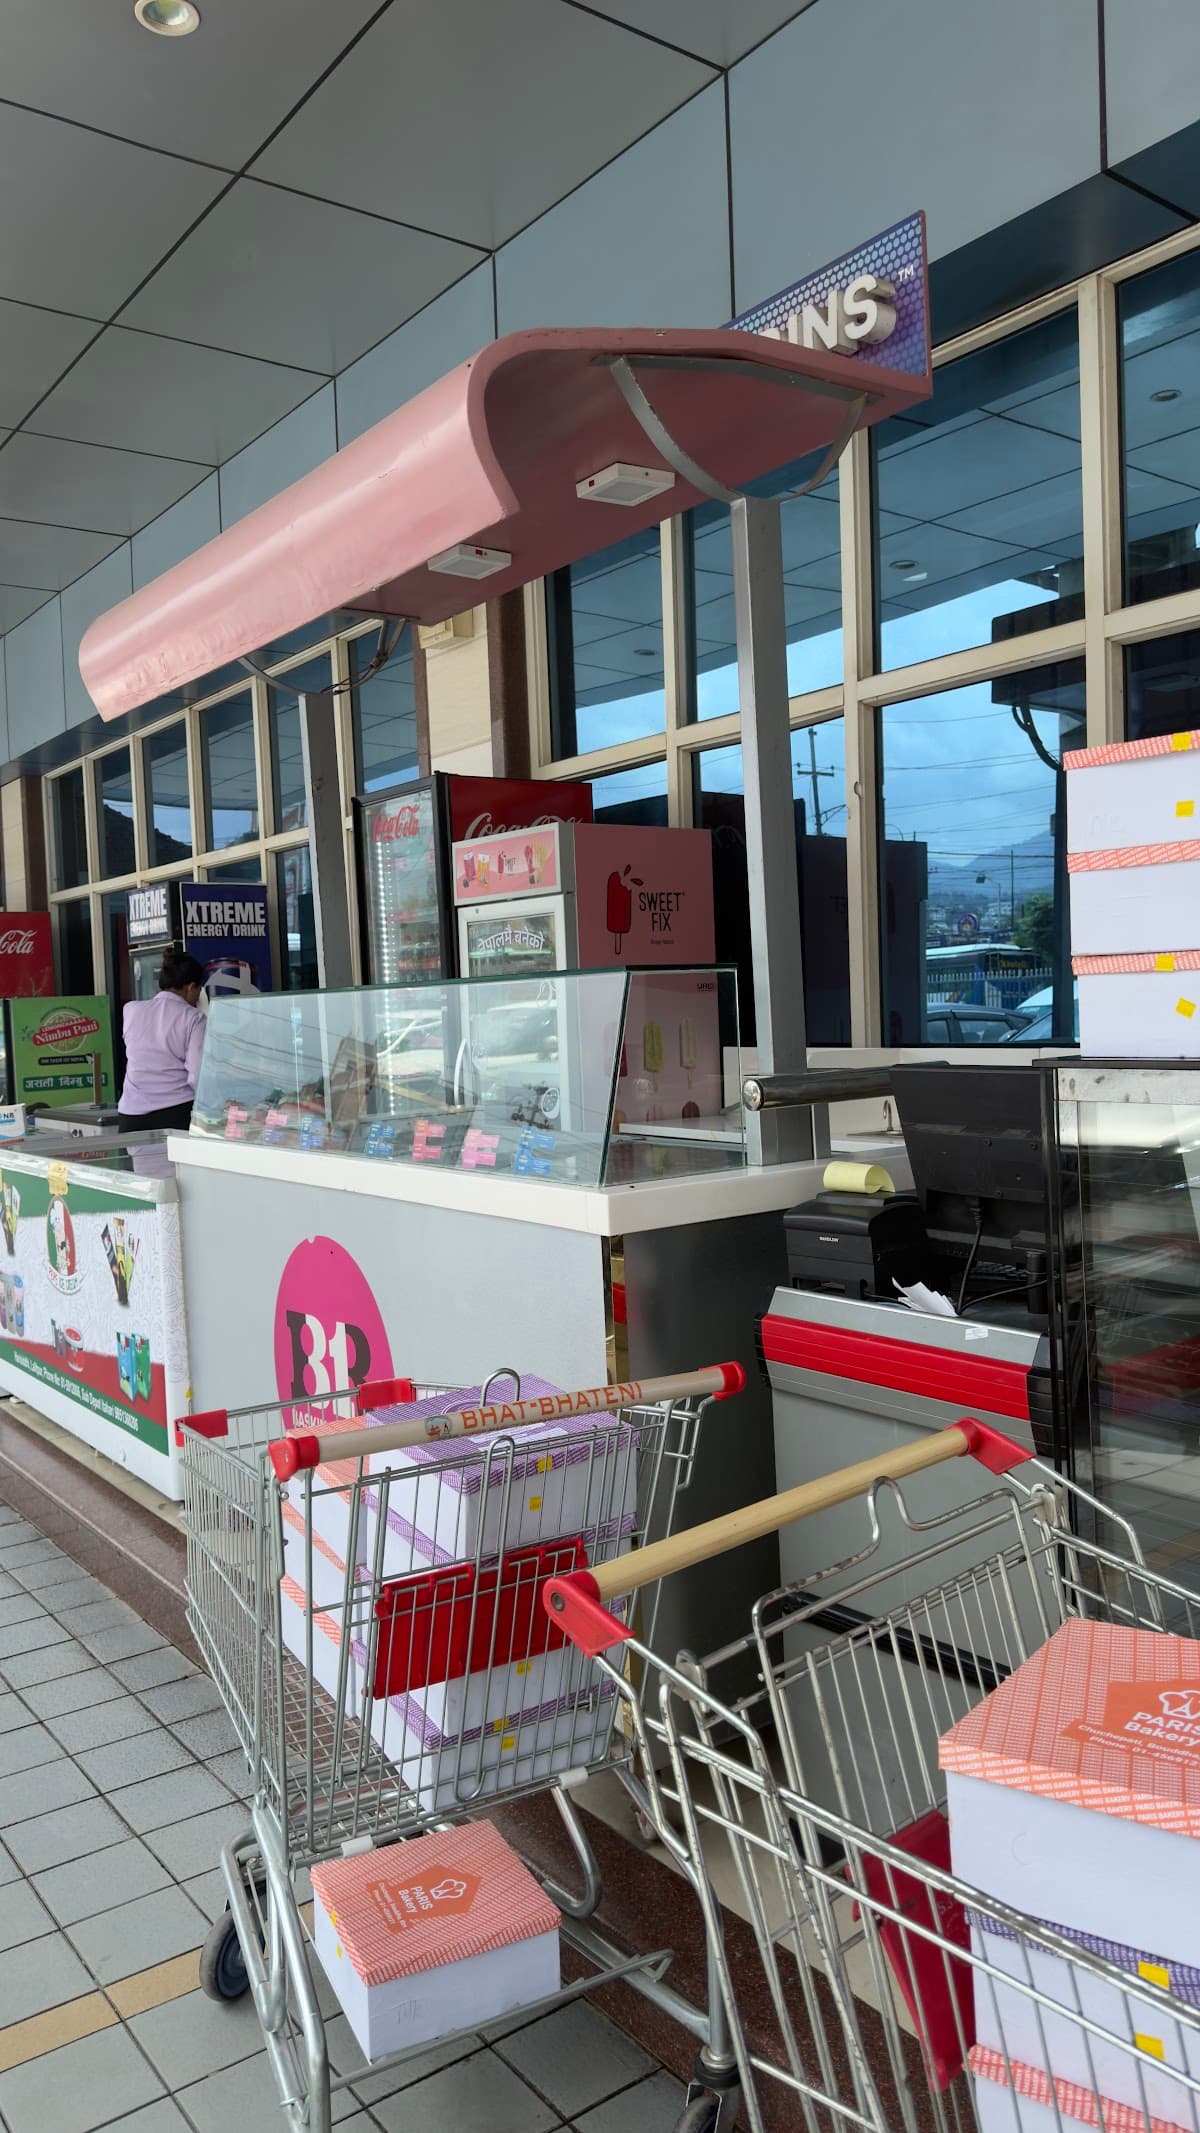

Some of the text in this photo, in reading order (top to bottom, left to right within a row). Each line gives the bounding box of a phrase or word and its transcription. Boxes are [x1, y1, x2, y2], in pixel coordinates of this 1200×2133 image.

[758, 274, 895, 354] INS
[372, 804, 419, 842] Coca-Cola
[129, 888, 168, 920] XTREME
[185, 901, 266, 924] XTREME
[638, 892, 682, 912] SWEET
[186, 923, 266, 937] ENERGY DRINK
[651, 912, 672, 932] FIX
[36, 1020, 98, 1044] Nimbu Pani
[461, 1382, 643, 1430] BHAT-BHATENI
[1124, 1721, 1200, 1747] Bakery
[398, 1889, 418, 1912] Bakery
[411, 1886, 433, 1910] PARIS
